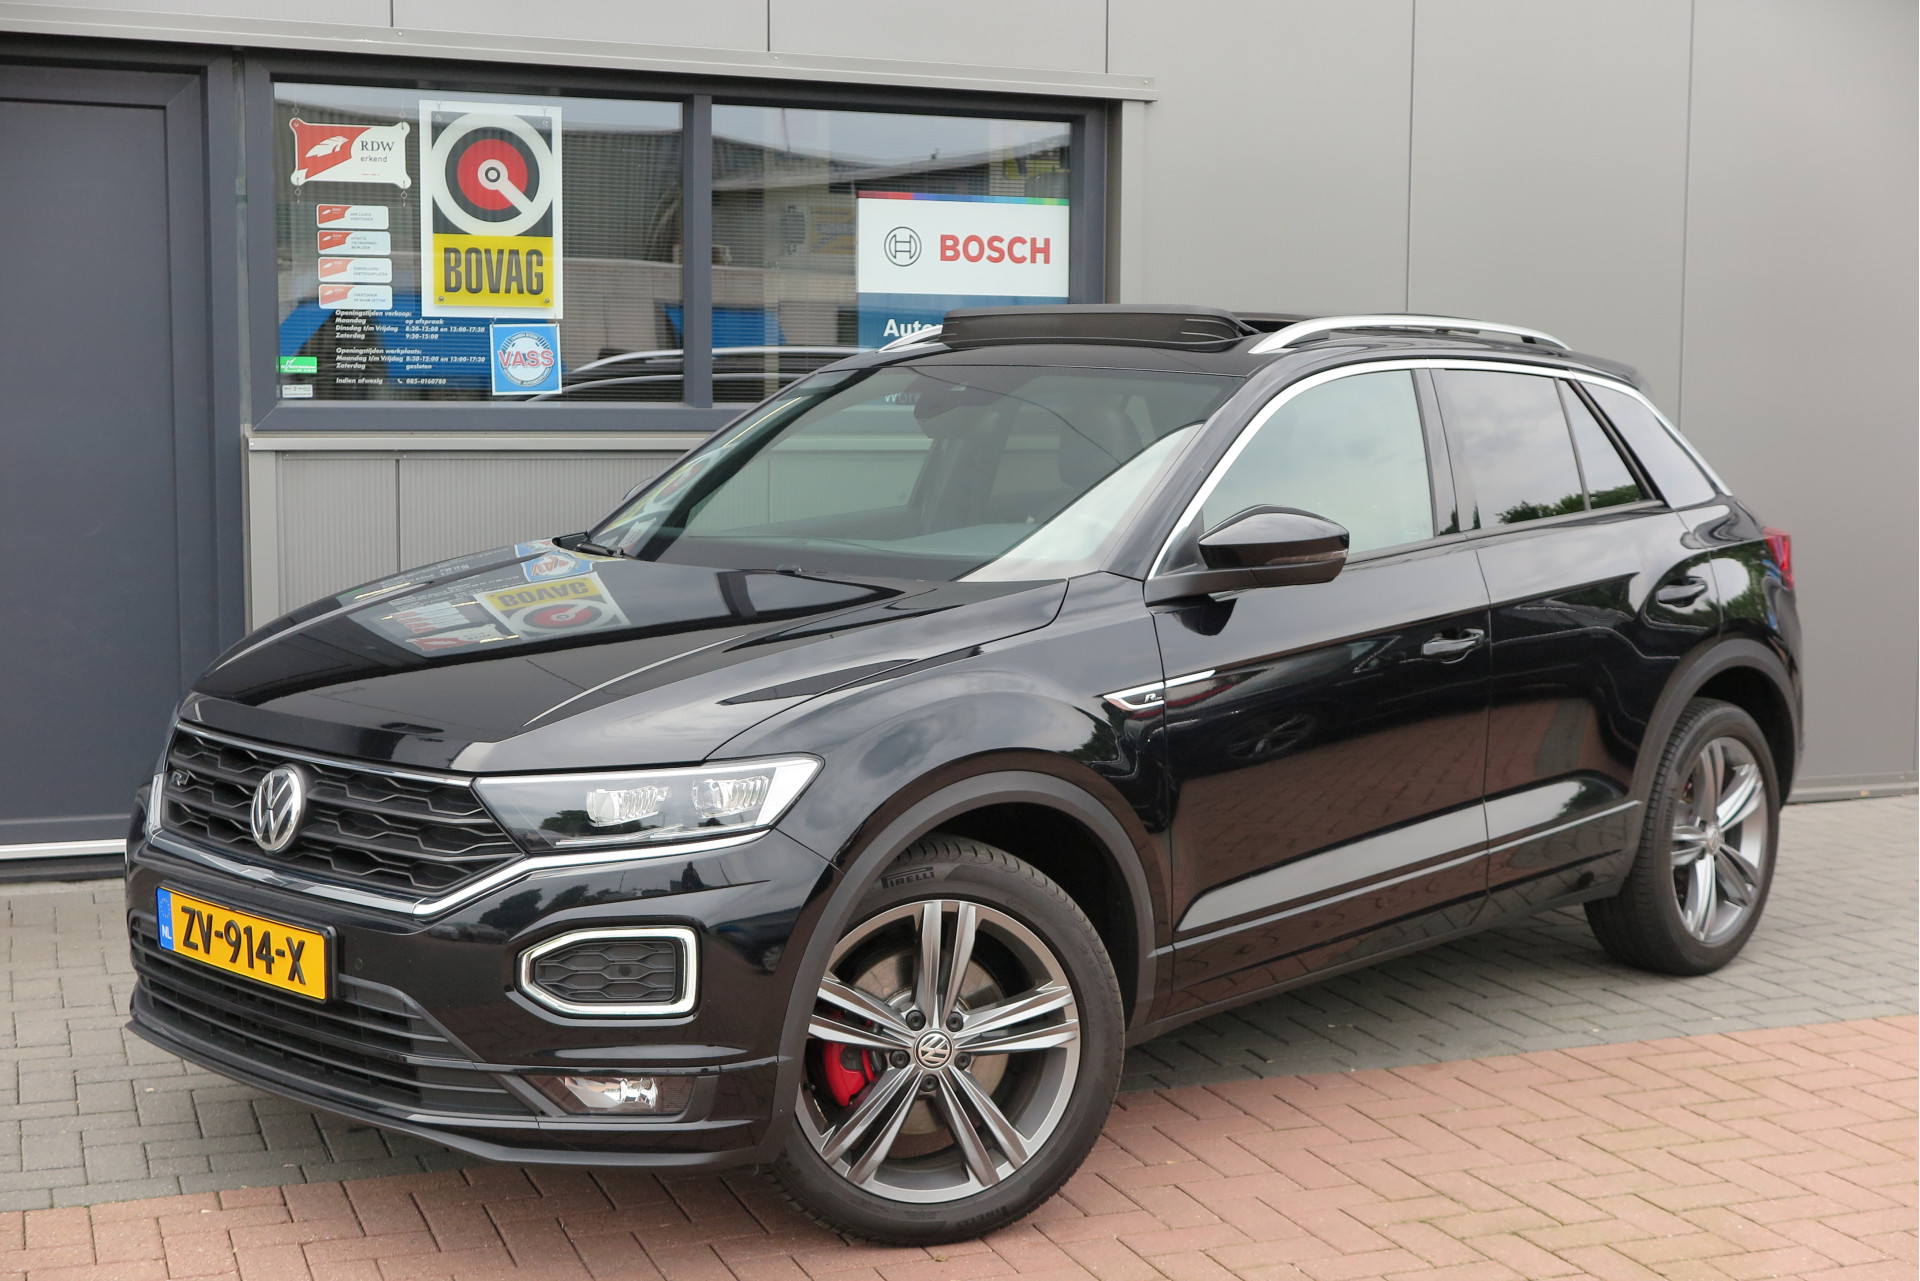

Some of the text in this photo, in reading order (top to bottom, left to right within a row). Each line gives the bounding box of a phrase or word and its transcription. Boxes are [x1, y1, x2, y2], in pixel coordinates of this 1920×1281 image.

[361, 140, 394, 152] RDW
[360, 155, 388, 163] erkend
[940, 234, 1050, 264] BOSCH
[444, 247, 544, 295] BOVAG
[498, 350, 554, 367] VASS
[881, 866, 934, 890] PIRELLI
[162, 924, 172, 940] NL
[181, 905, 306, 985] ZV-914-X
